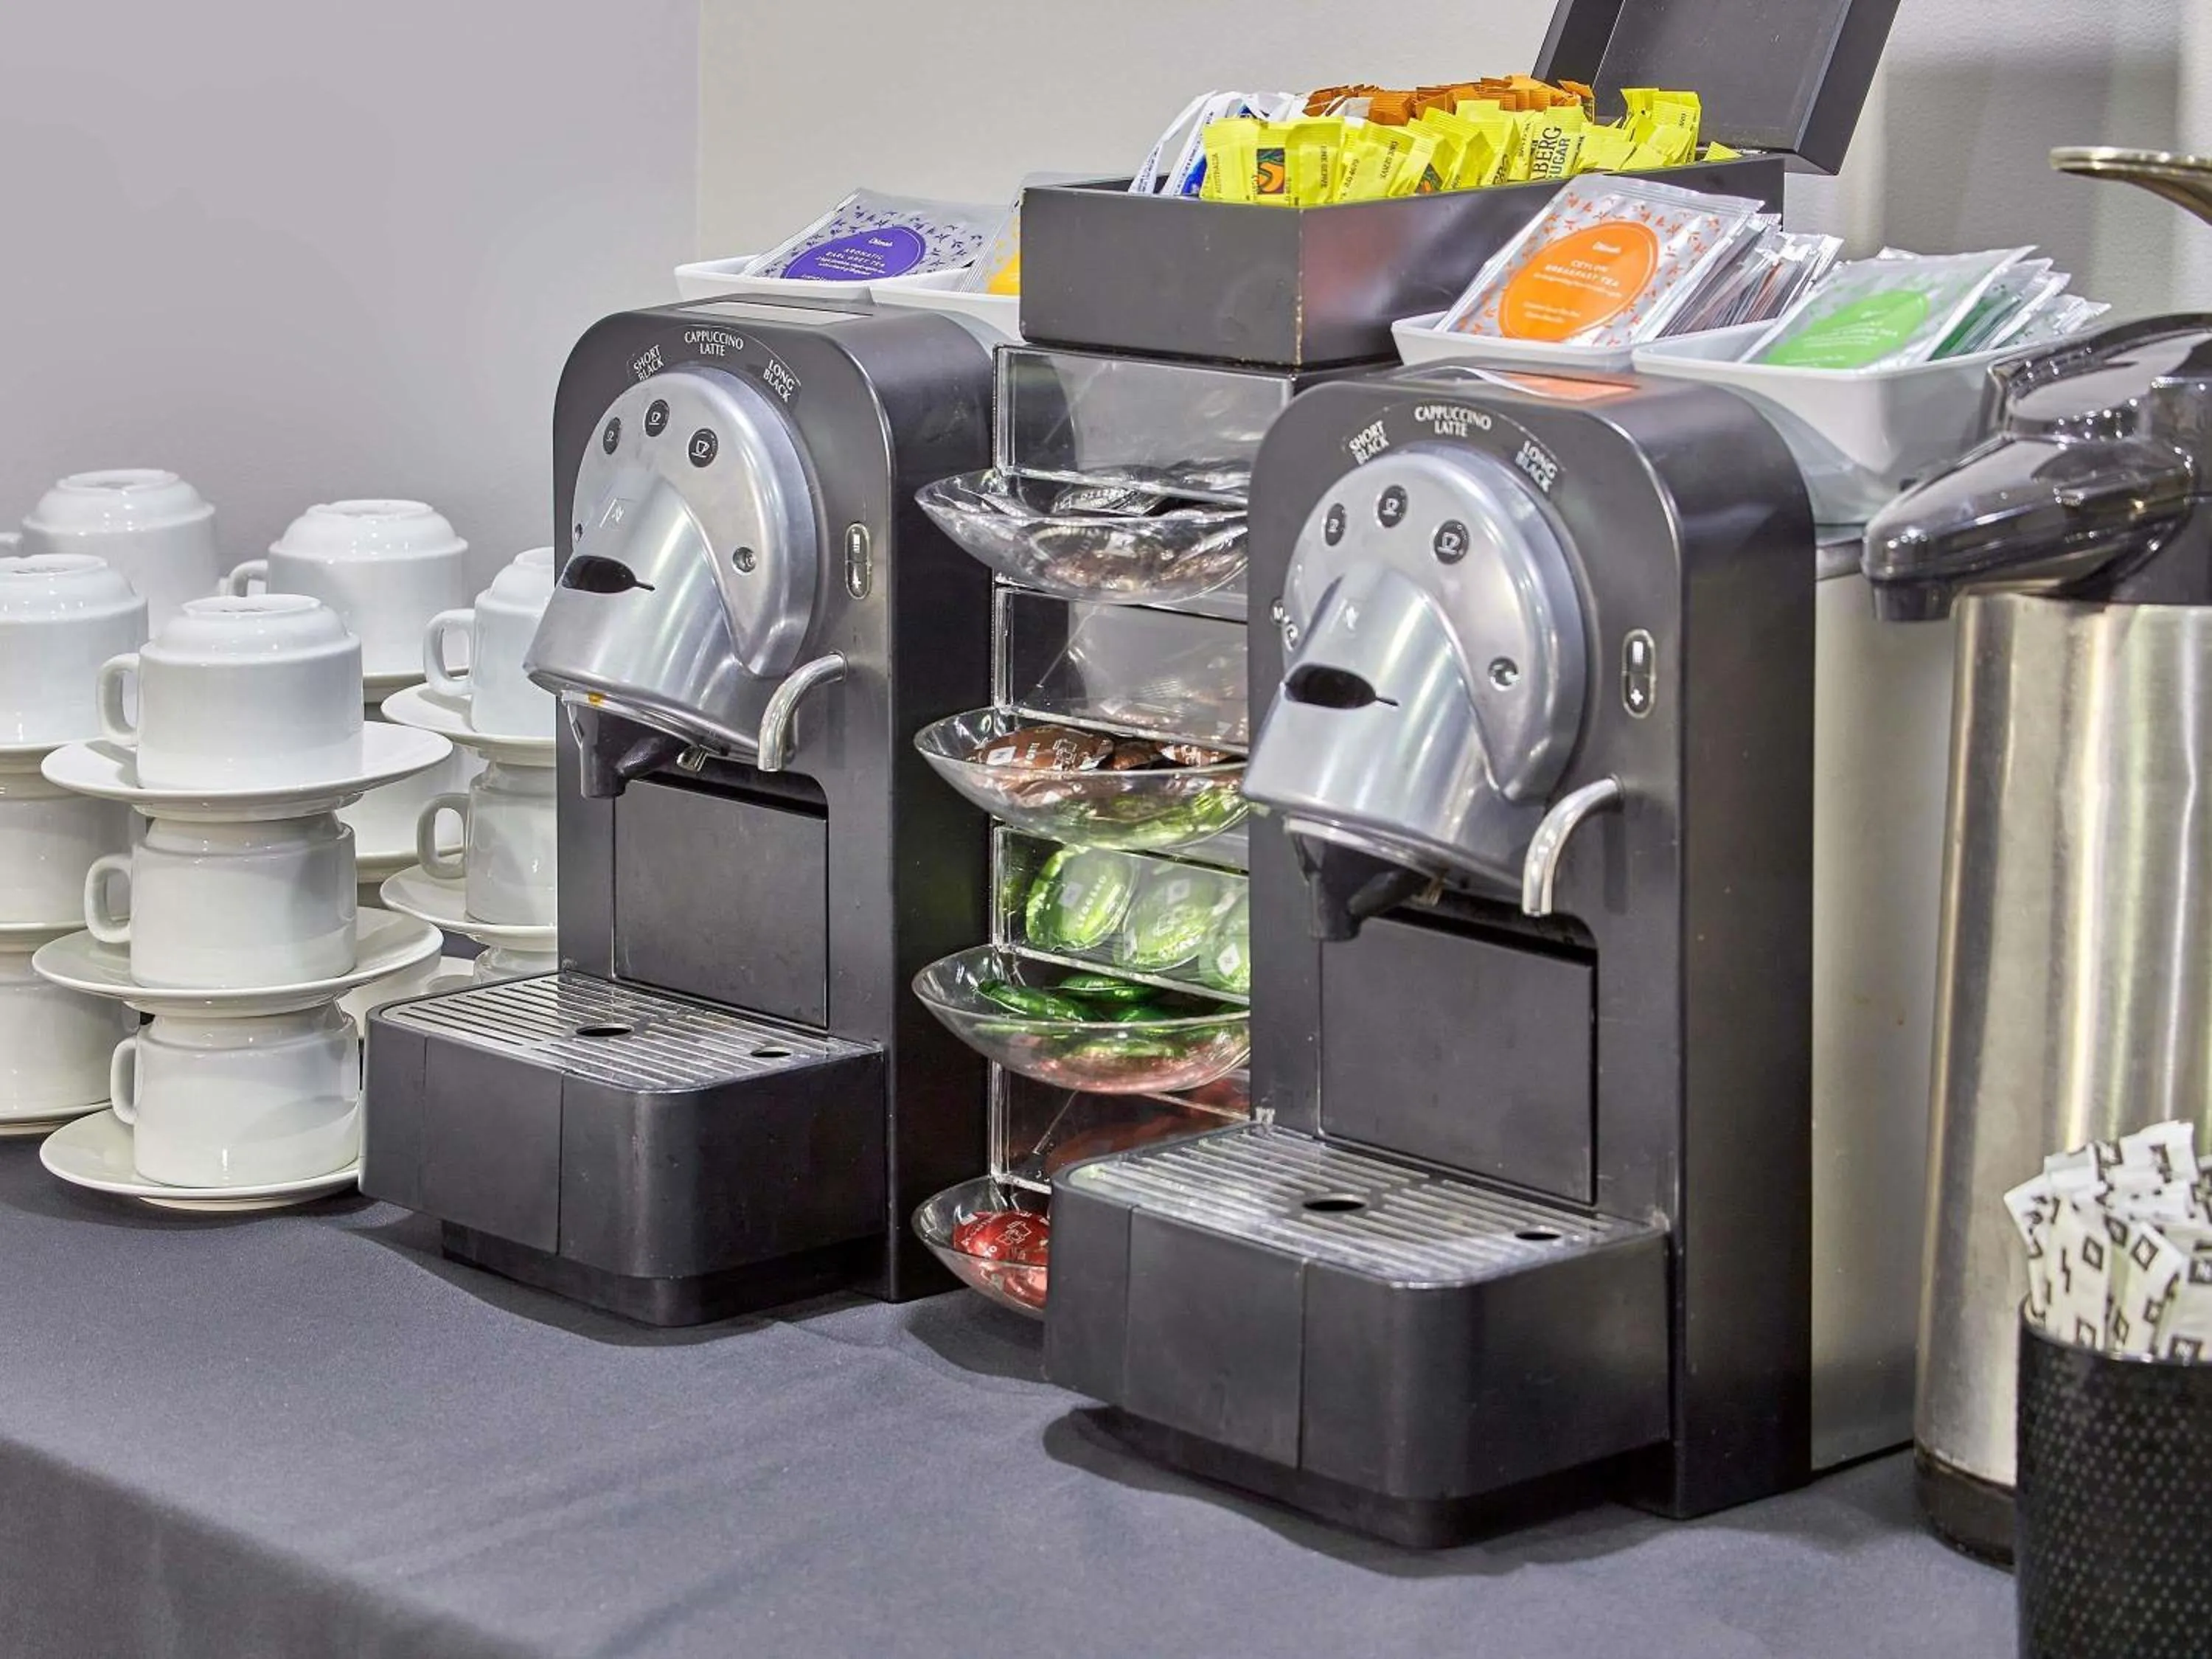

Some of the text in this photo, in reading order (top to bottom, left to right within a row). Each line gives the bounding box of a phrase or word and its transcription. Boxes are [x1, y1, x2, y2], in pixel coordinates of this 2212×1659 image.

[684, 330, 744, 350] CAPPUCCINO
[700, 343, 726, 356] LATTE
[633, 344, 661, 373] SHORT
[639, 355, 664, 381] BLACK
[763, 369, 791, 403] BLACK
[768, 359, 795, 391] LONG
[1414, 406, 1492, 431] CAPPUCCINO
[1434, 421, 1467, 437] LATTE
[1349, 420, 1384, 451] SHORT
[1354, 434, 1389, 465] BLACK
[1515, 451, 1552, 493] BLACK
[1523, 440, 1557, 479] LONG
